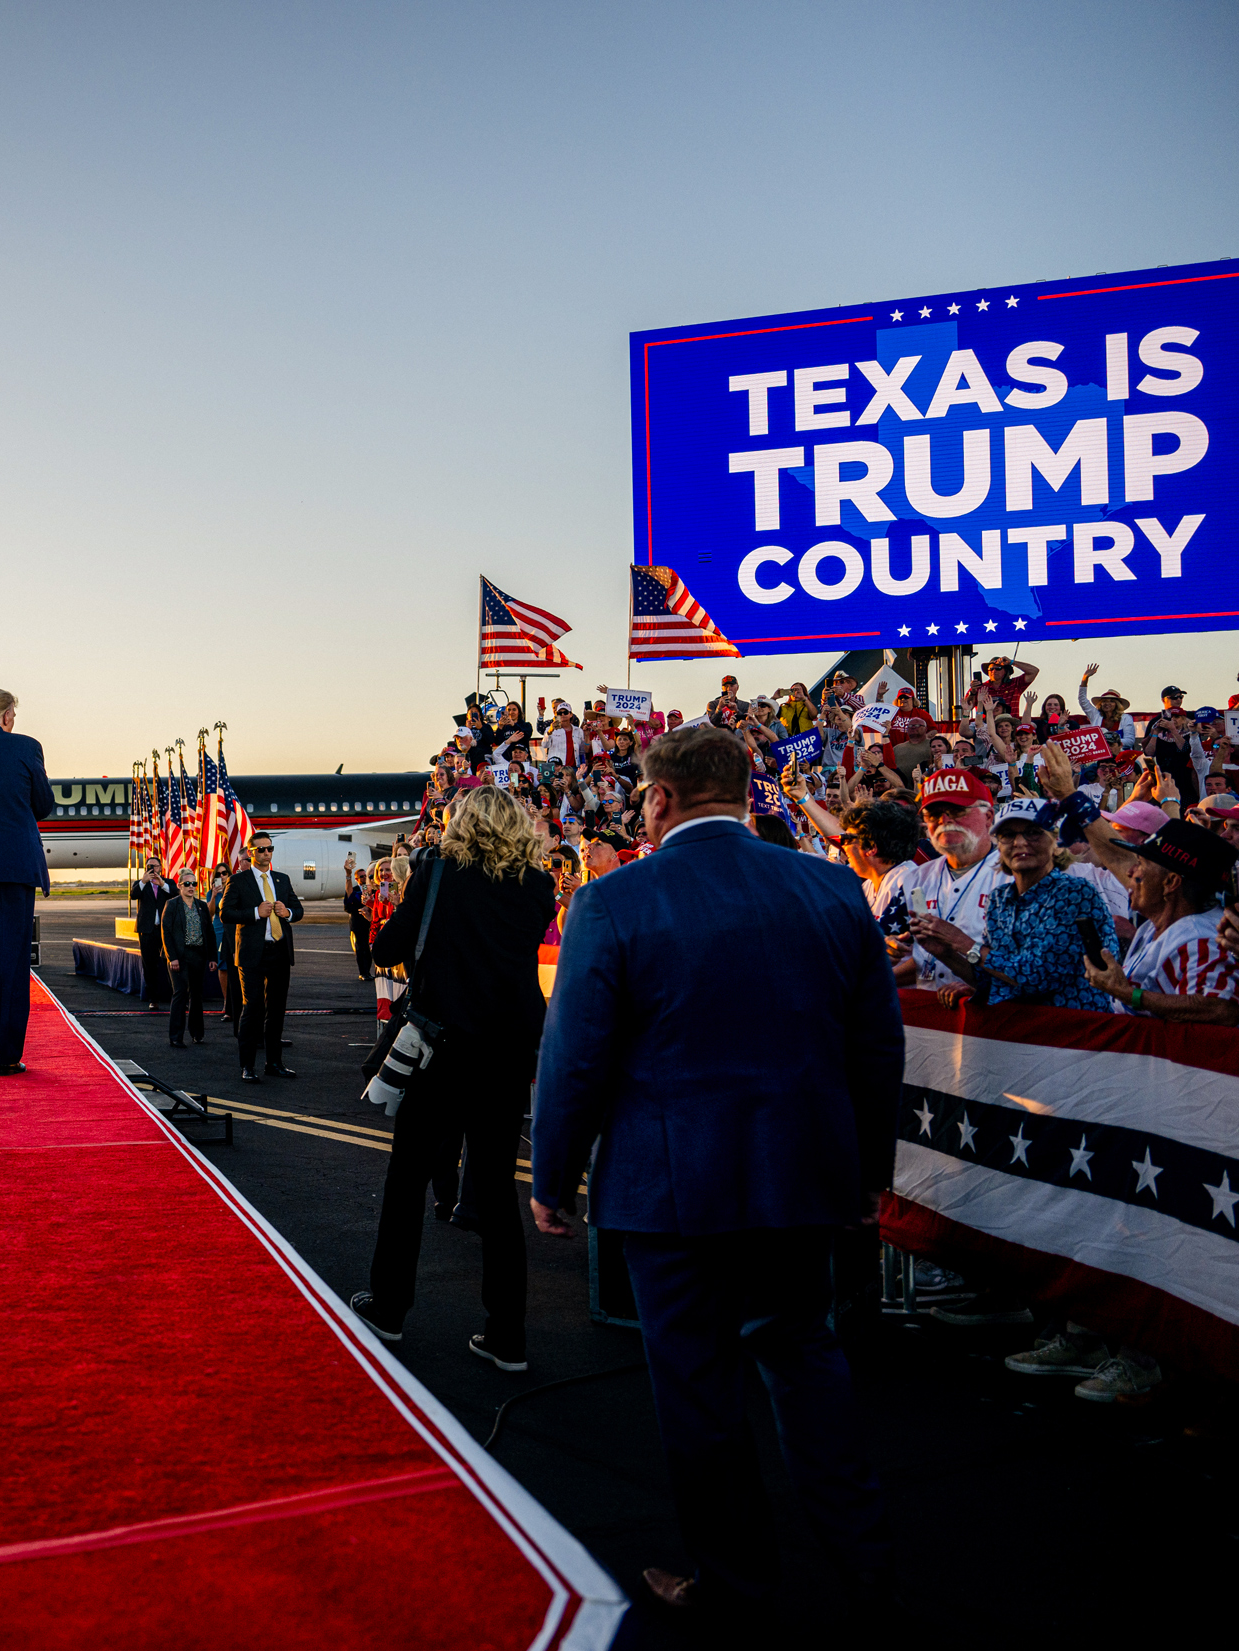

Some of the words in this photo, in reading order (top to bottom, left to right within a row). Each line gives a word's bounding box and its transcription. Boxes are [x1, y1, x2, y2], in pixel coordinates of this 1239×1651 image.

[728, 341, 1069, 437] TEXAS
[1105, 325, 1205, 402] IS
[727, 410, 1210, 532] TRUMP
[737, 513, 1207, 605] COUNTRY
[611, 694, 648, 703] TRUMP
[615, 701, 641, 710] 2024
[778, 735, 817, 756] TRUMP
[1064, 742, 1097, 757] 2024
[493, 769, 510, 778] TRU
[753, 779, 779, 794] TRU
[923, 775, 970, 797] MAGA
[764, 791, 781, 806] 20
[999, 800, 1038, 818] USA
[1161, 842, 1198, 868] ULTRA
